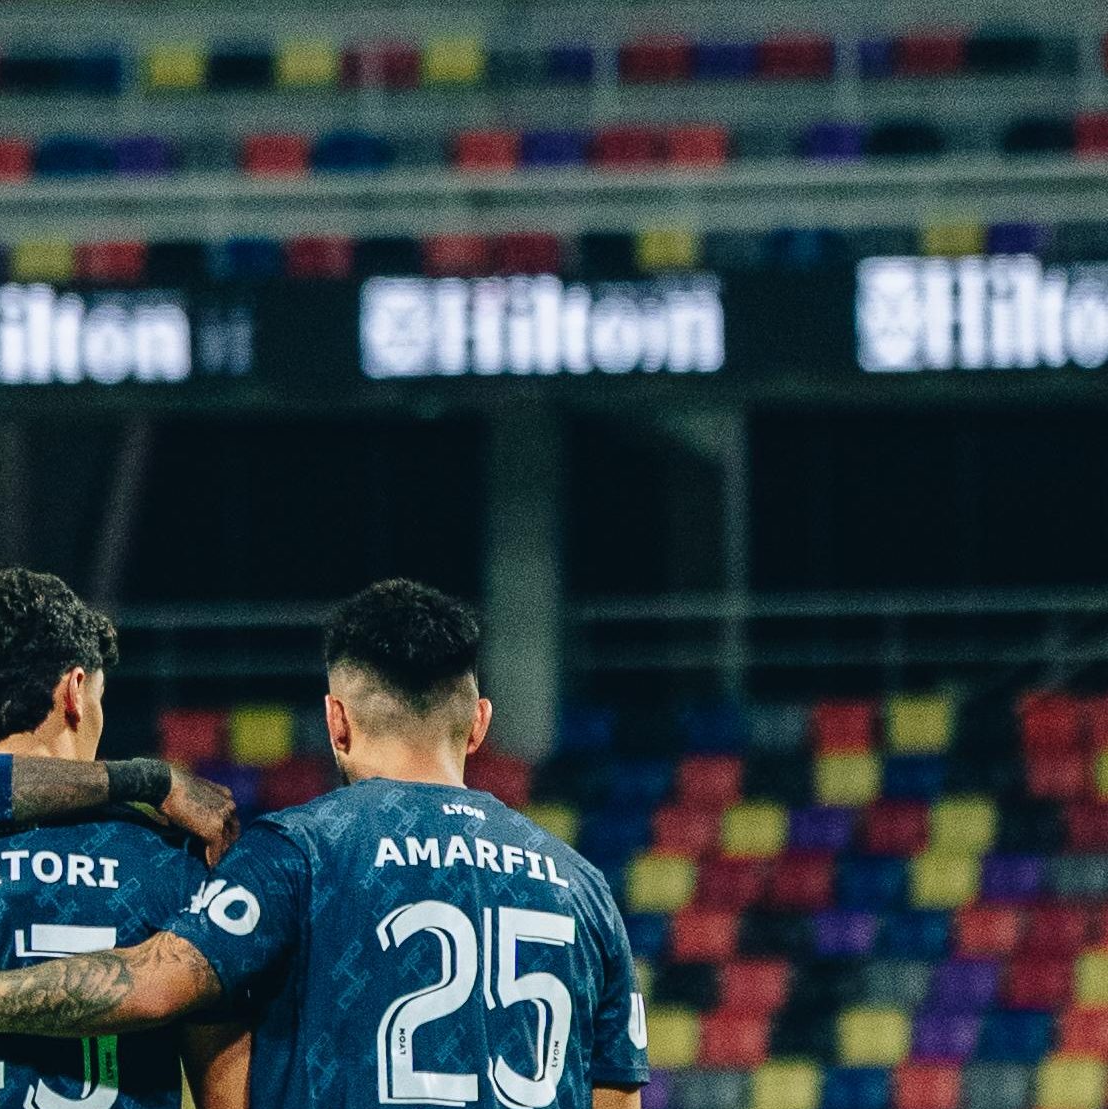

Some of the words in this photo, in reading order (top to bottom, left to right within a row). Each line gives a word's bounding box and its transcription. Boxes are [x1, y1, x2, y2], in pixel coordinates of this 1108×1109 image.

[435, 272, 724, 376] Hilton
[442, 804, 486, 821] LYON
[374, 835, 569, 888] AMARFIL
